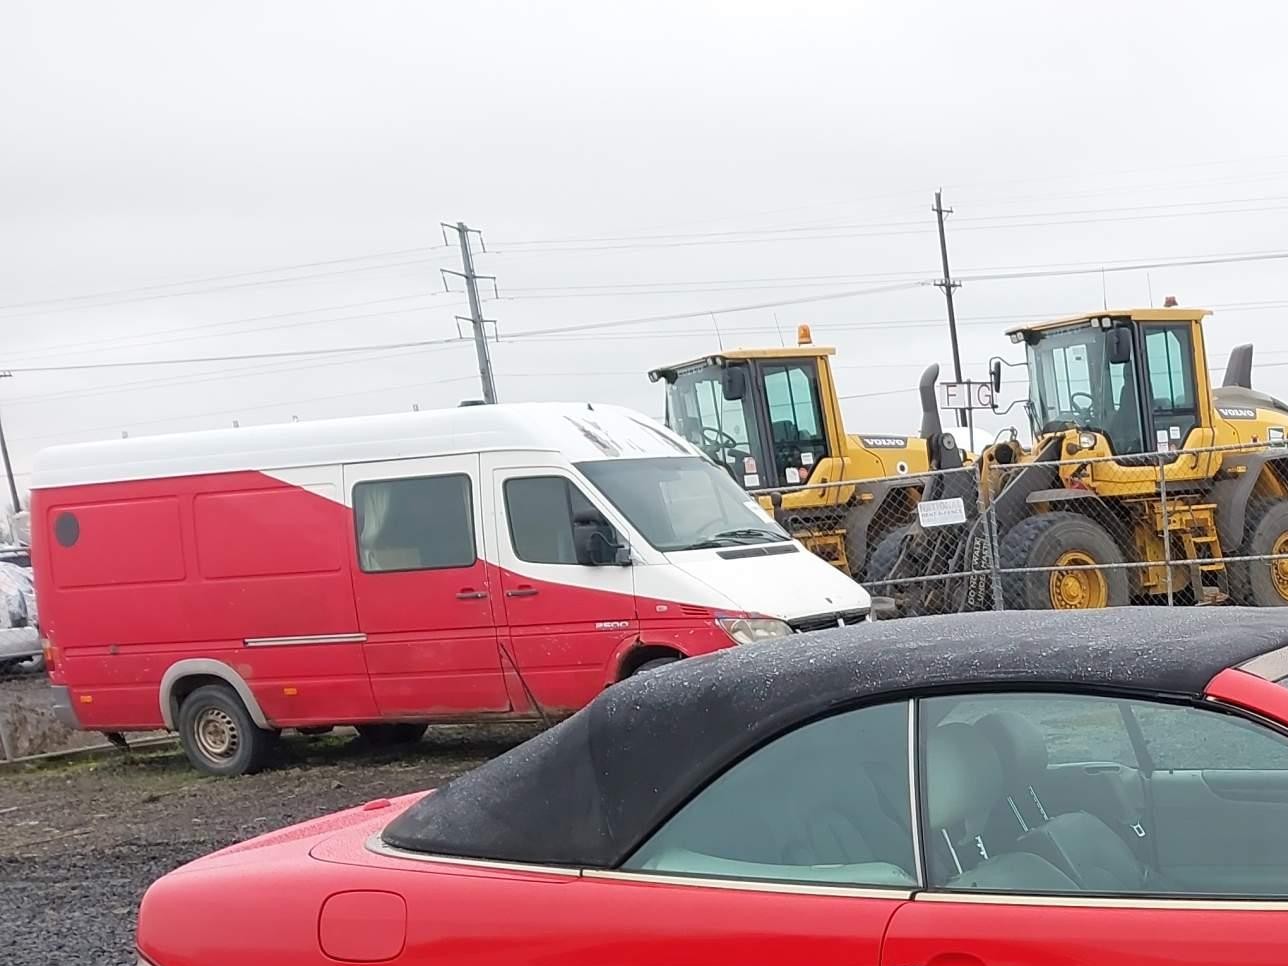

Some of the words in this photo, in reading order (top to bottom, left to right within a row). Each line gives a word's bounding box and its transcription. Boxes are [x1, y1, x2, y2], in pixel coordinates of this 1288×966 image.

[946, 384, 957, 407] F
[977, 384, 992, 407] G
[1218, 408, 1255, 418] VOLVO
[863, 438, 905, 446] VOLVO
